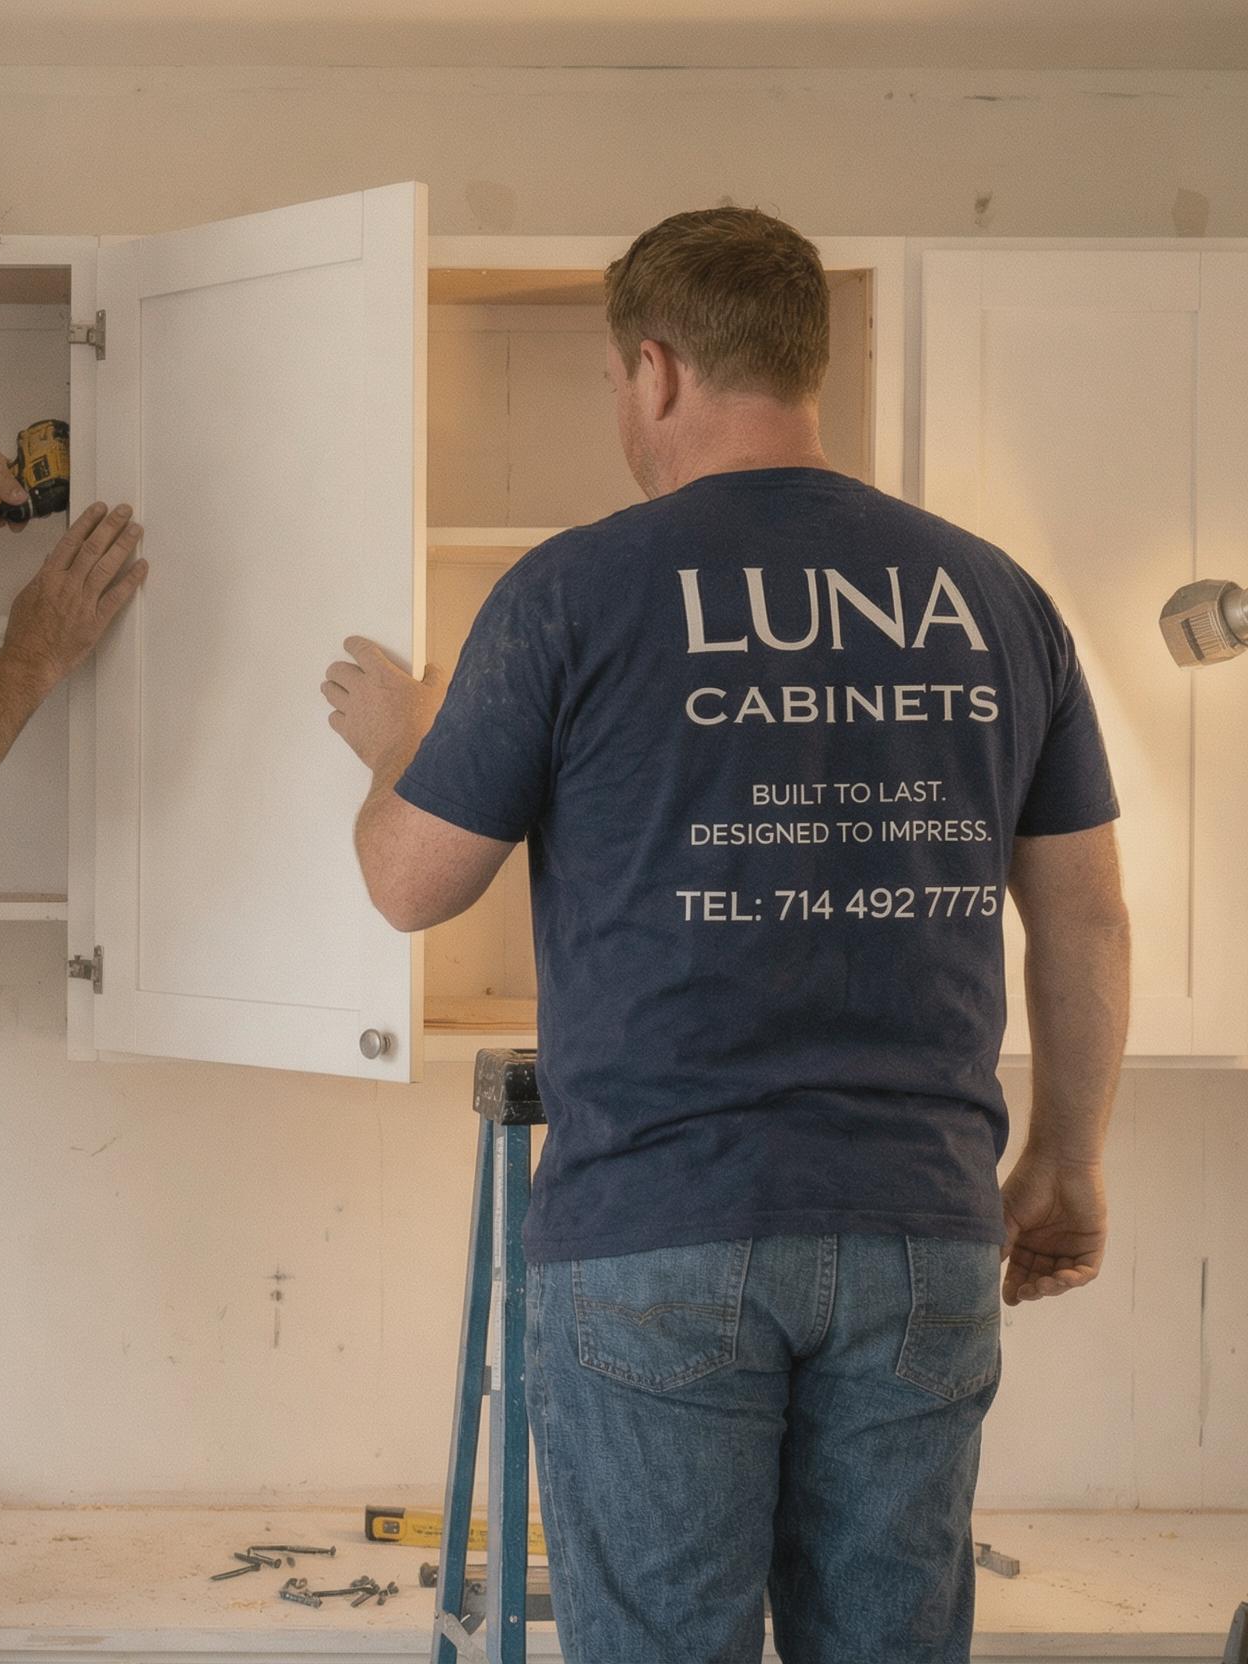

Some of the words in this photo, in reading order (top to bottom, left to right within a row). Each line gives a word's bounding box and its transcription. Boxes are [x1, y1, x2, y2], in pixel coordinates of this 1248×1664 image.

[678, 566, 989, 653] LUNA
[685, 684, 999, 726] CABINETS
[752, 783, 827, 806] BUILT
[833, 782, 871, 804] TO
[878, 780, 947, 803] LAST.
[690, 823, 829, 846] DESIGNED
[836, 821, 873, 843] TO
[881, 820, 993, 843] IMPRESS.
[676, 890, 763, 922] TEL:
[774, 889, 834, 921] 714
[845, 887, 915, 920] 492
[924, 885, 998, 918] 7775
